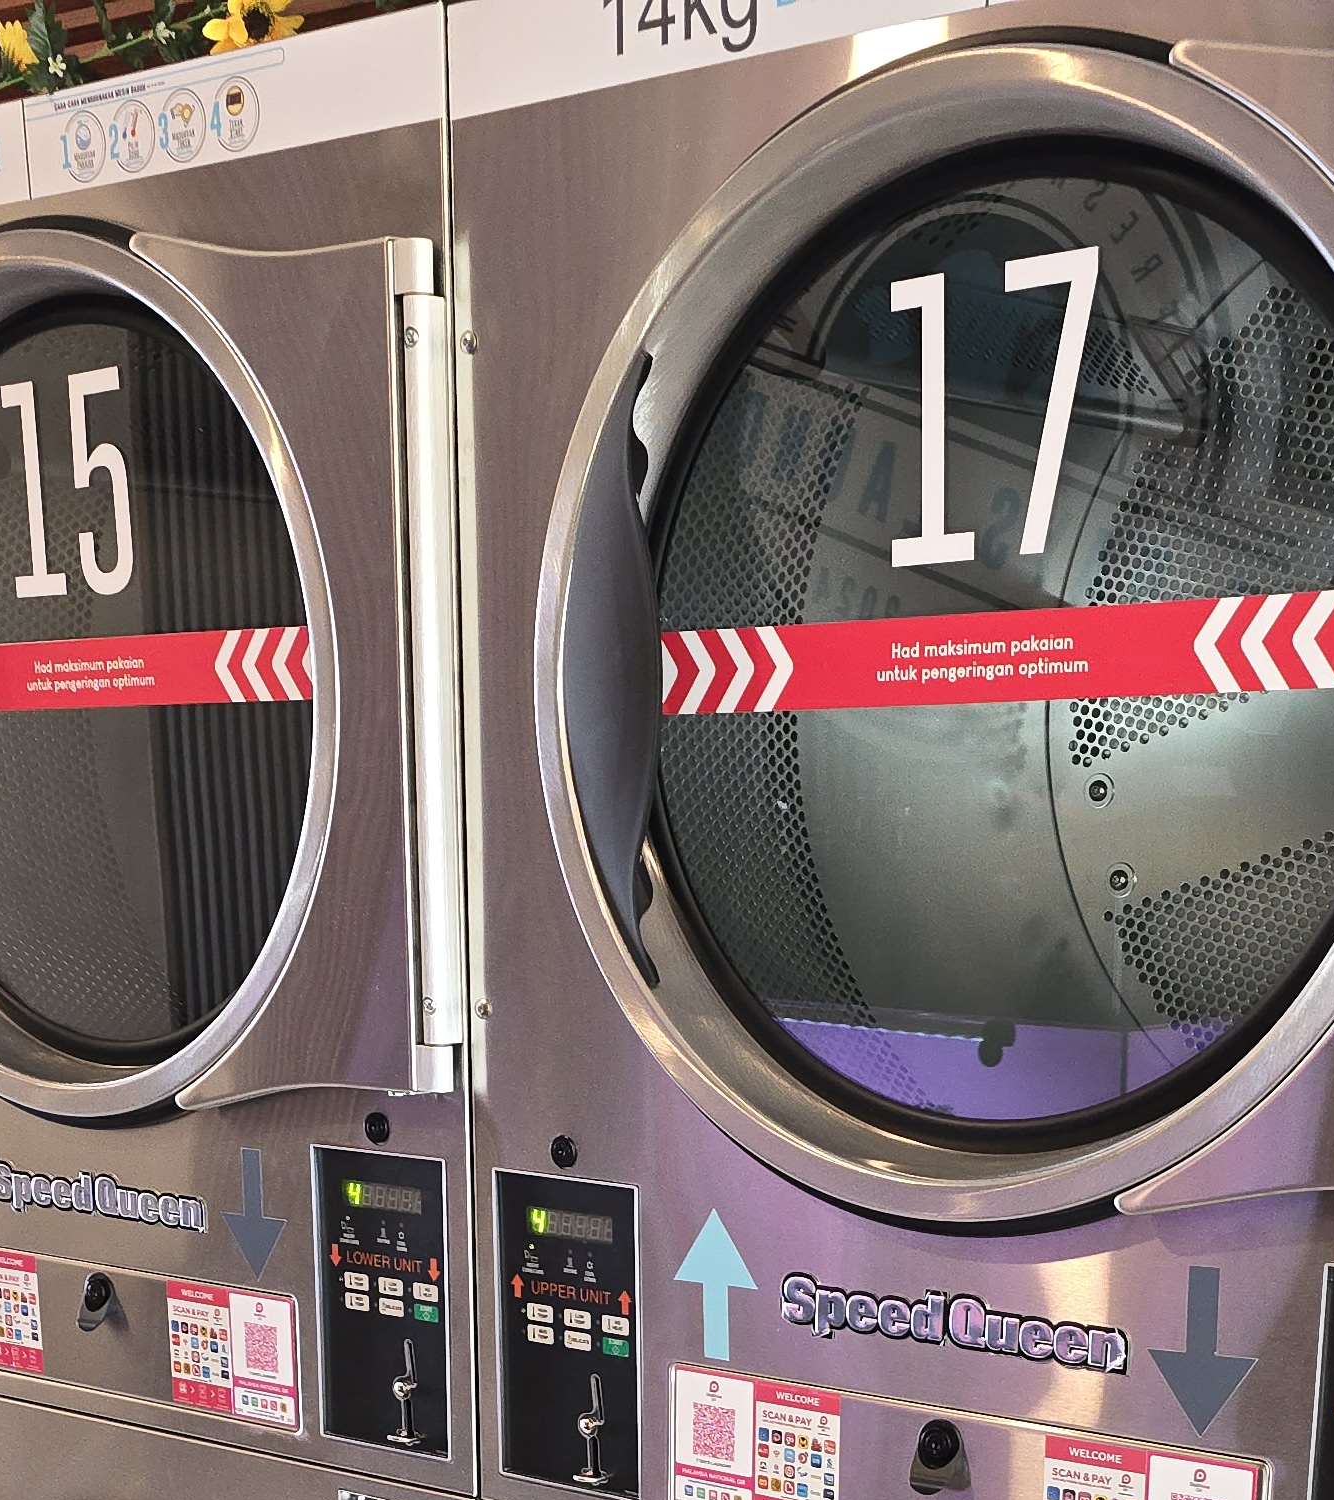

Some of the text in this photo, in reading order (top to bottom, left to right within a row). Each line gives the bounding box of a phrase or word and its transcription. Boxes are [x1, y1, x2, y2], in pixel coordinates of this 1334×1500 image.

[890, 246, 1099, 568] 17
[0, 366, 134, 601] 15
[890, 633, 1074, 661] Had maksimum pakaian
[34, 657, 145, 675] Had maksimum pakaian
[876, 656, 1089, 684] untuk pengeringan optimum
[26, 672, 155, 692] untuk pengeringan optimum
[94, 1172, 209, 1233] Queen
[347, 1181, 362, 1206] 4
[531, 1207, 547, 1236] 4
[346, 1250, 423, 1273] LOWER UNIT
[530, 1280, 612, 1305] UPPER UNIT
[172, 1304, 191, 1315] SCAN
[781, 1271, 1130, 1376] Speed Queen
[775, 1390, 820, 1407] WELCOME
[762, 1410, 813, 1427] SCAN & PAY
[1068, 1446, 1123, 1464] WELCOME
[1051, 1467, 1081, 1480] SCAN
[1082, 1472, 1090, 1481] &
[1091, 1474, 1112, 1486] PAY
